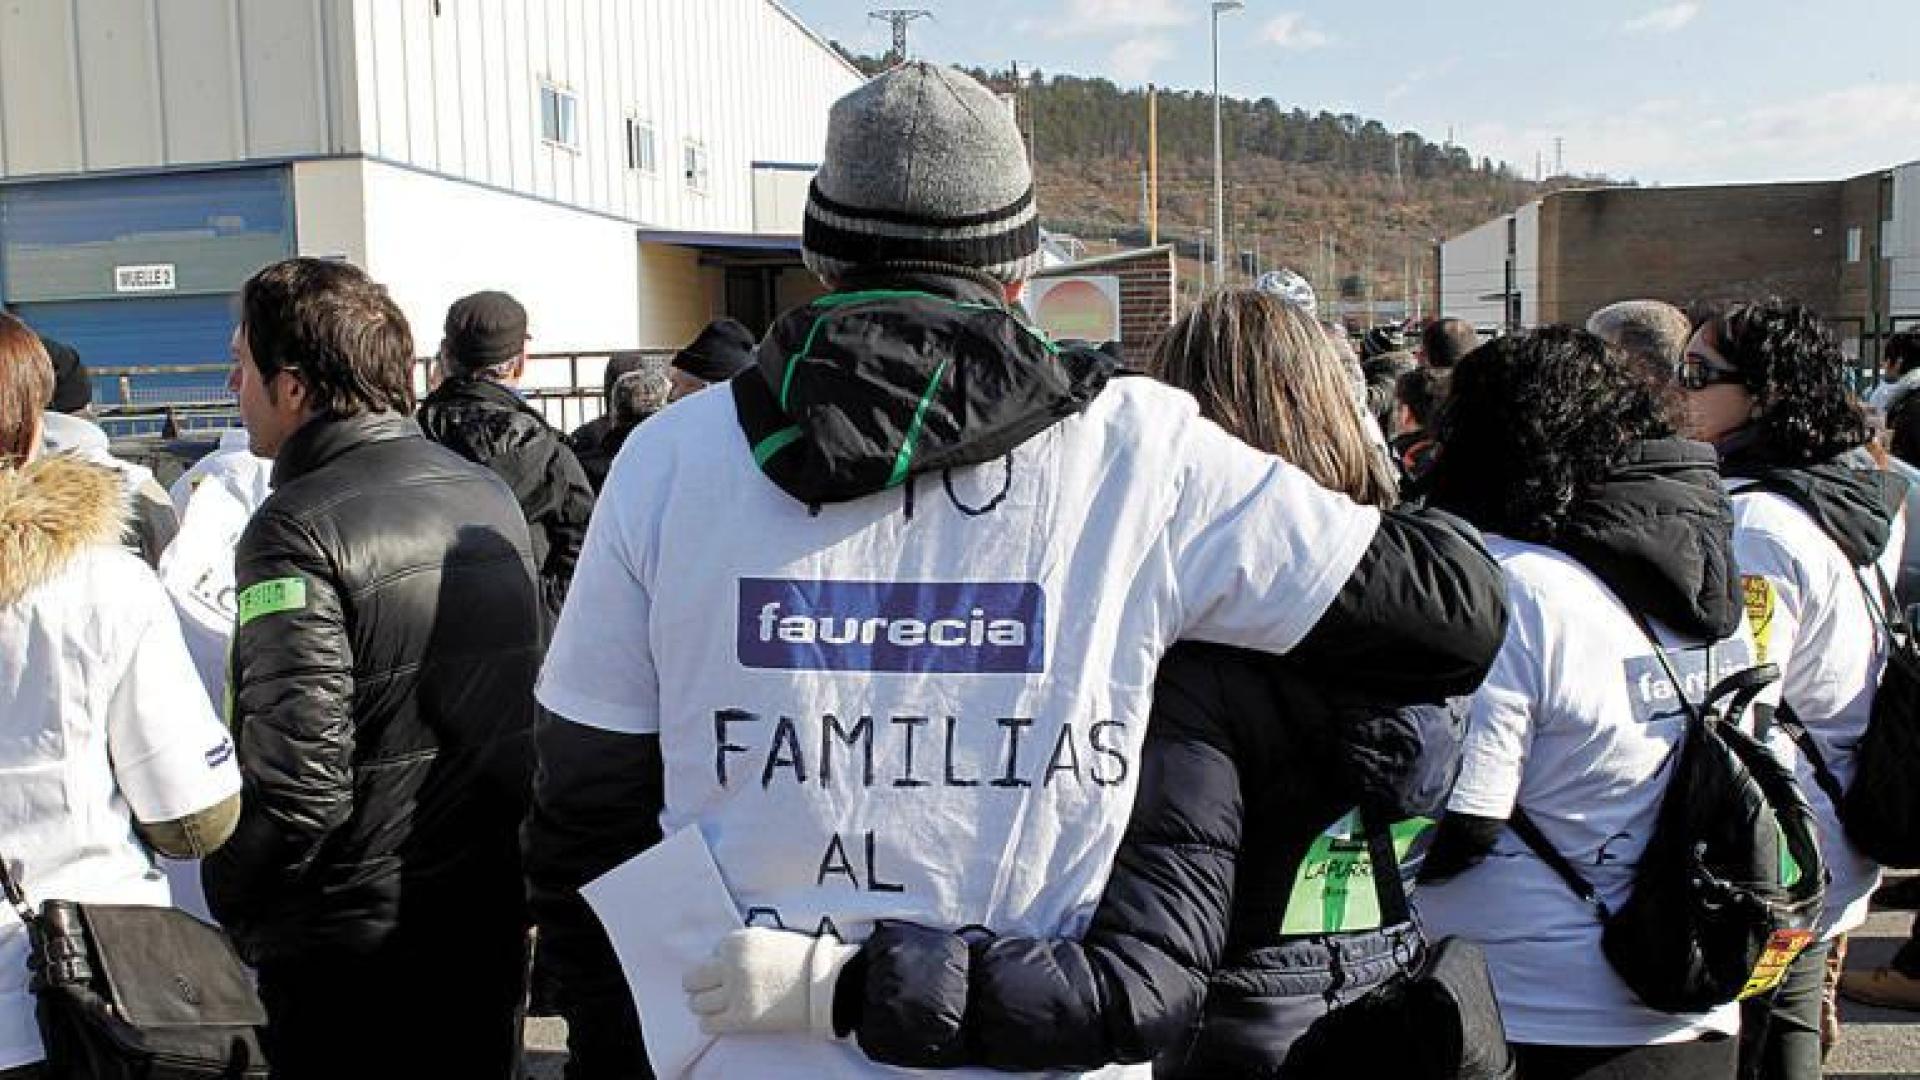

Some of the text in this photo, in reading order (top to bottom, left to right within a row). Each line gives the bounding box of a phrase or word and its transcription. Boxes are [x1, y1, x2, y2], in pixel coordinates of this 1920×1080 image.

[759, 602, 1025, 647] faurecia
[713, 707, 1129, 791] FAMILIAS
[816, 830, 904, 893] AL
